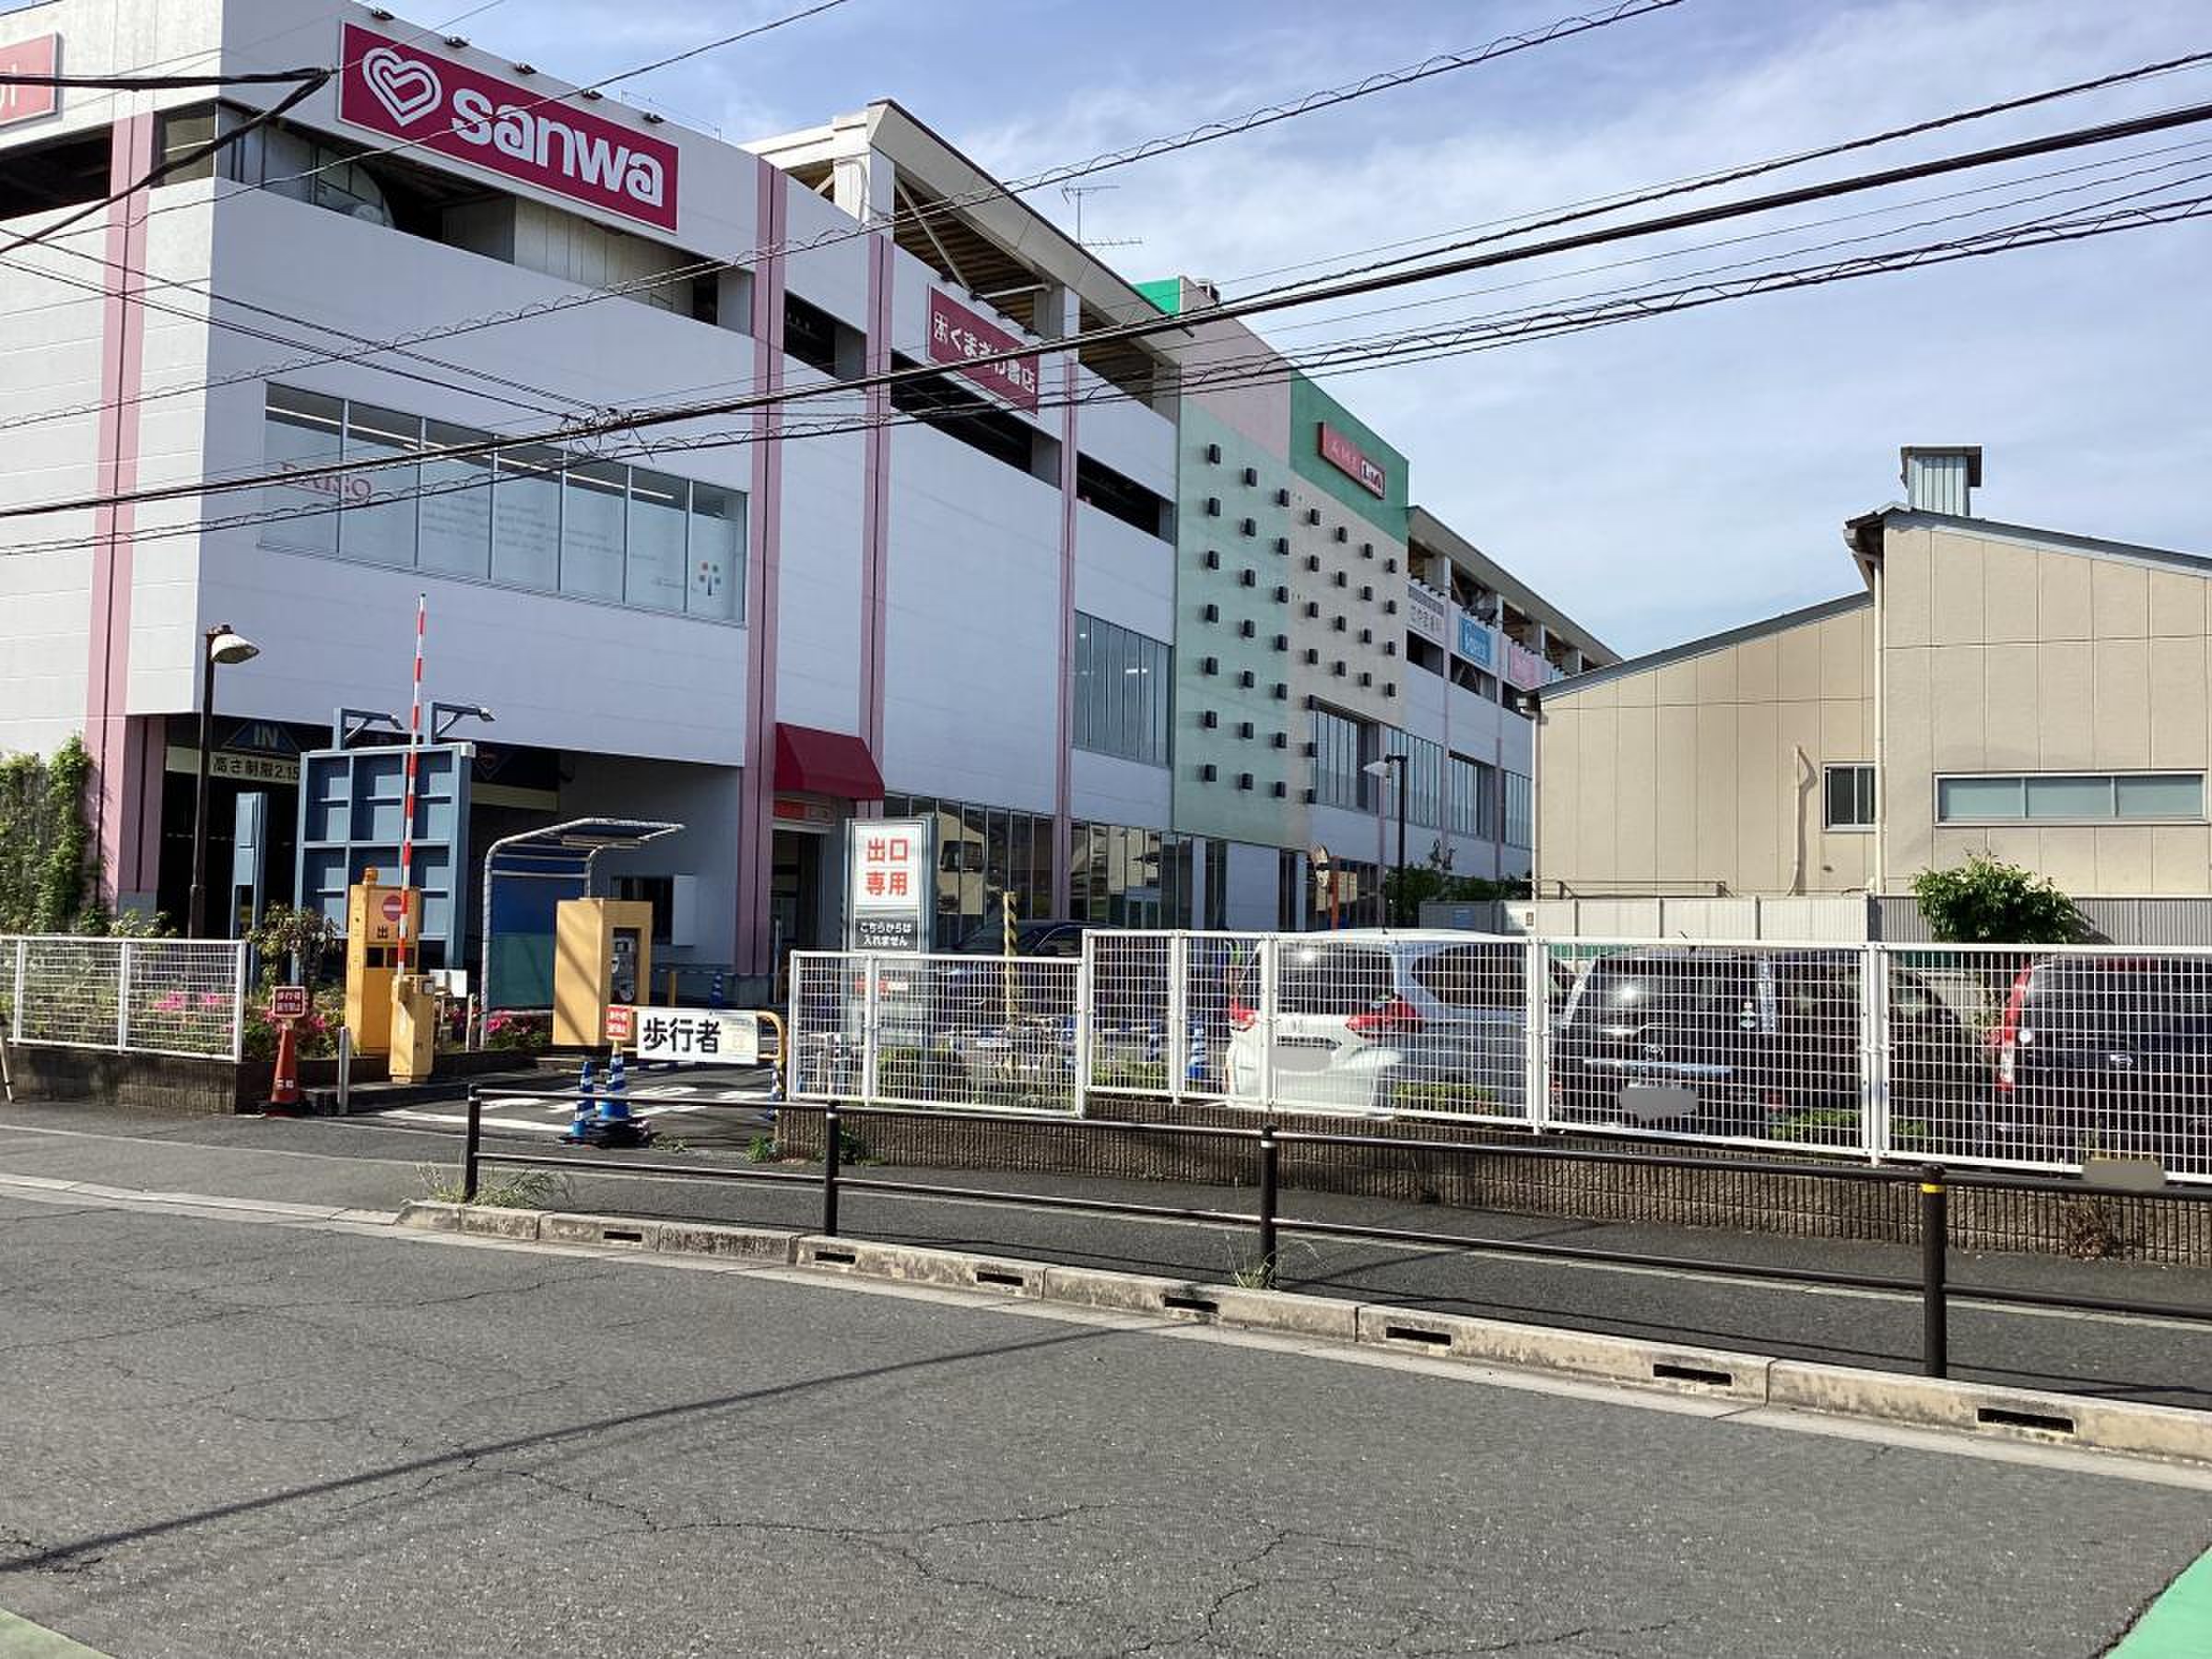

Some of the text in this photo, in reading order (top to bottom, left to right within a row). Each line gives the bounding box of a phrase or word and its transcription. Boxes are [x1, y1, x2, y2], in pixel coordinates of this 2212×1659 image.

[451, 88, 664, 207] sanwa
[253, 724, 278, 747] IN
[867, 838, 909, 862] 出口
[865, 871, 908, 896] 専用
[860, 922, 912, 934] こちらからは
[864, 934, 908, 947] 入れません
[643, 1018, 721, 1053] 歩行者
